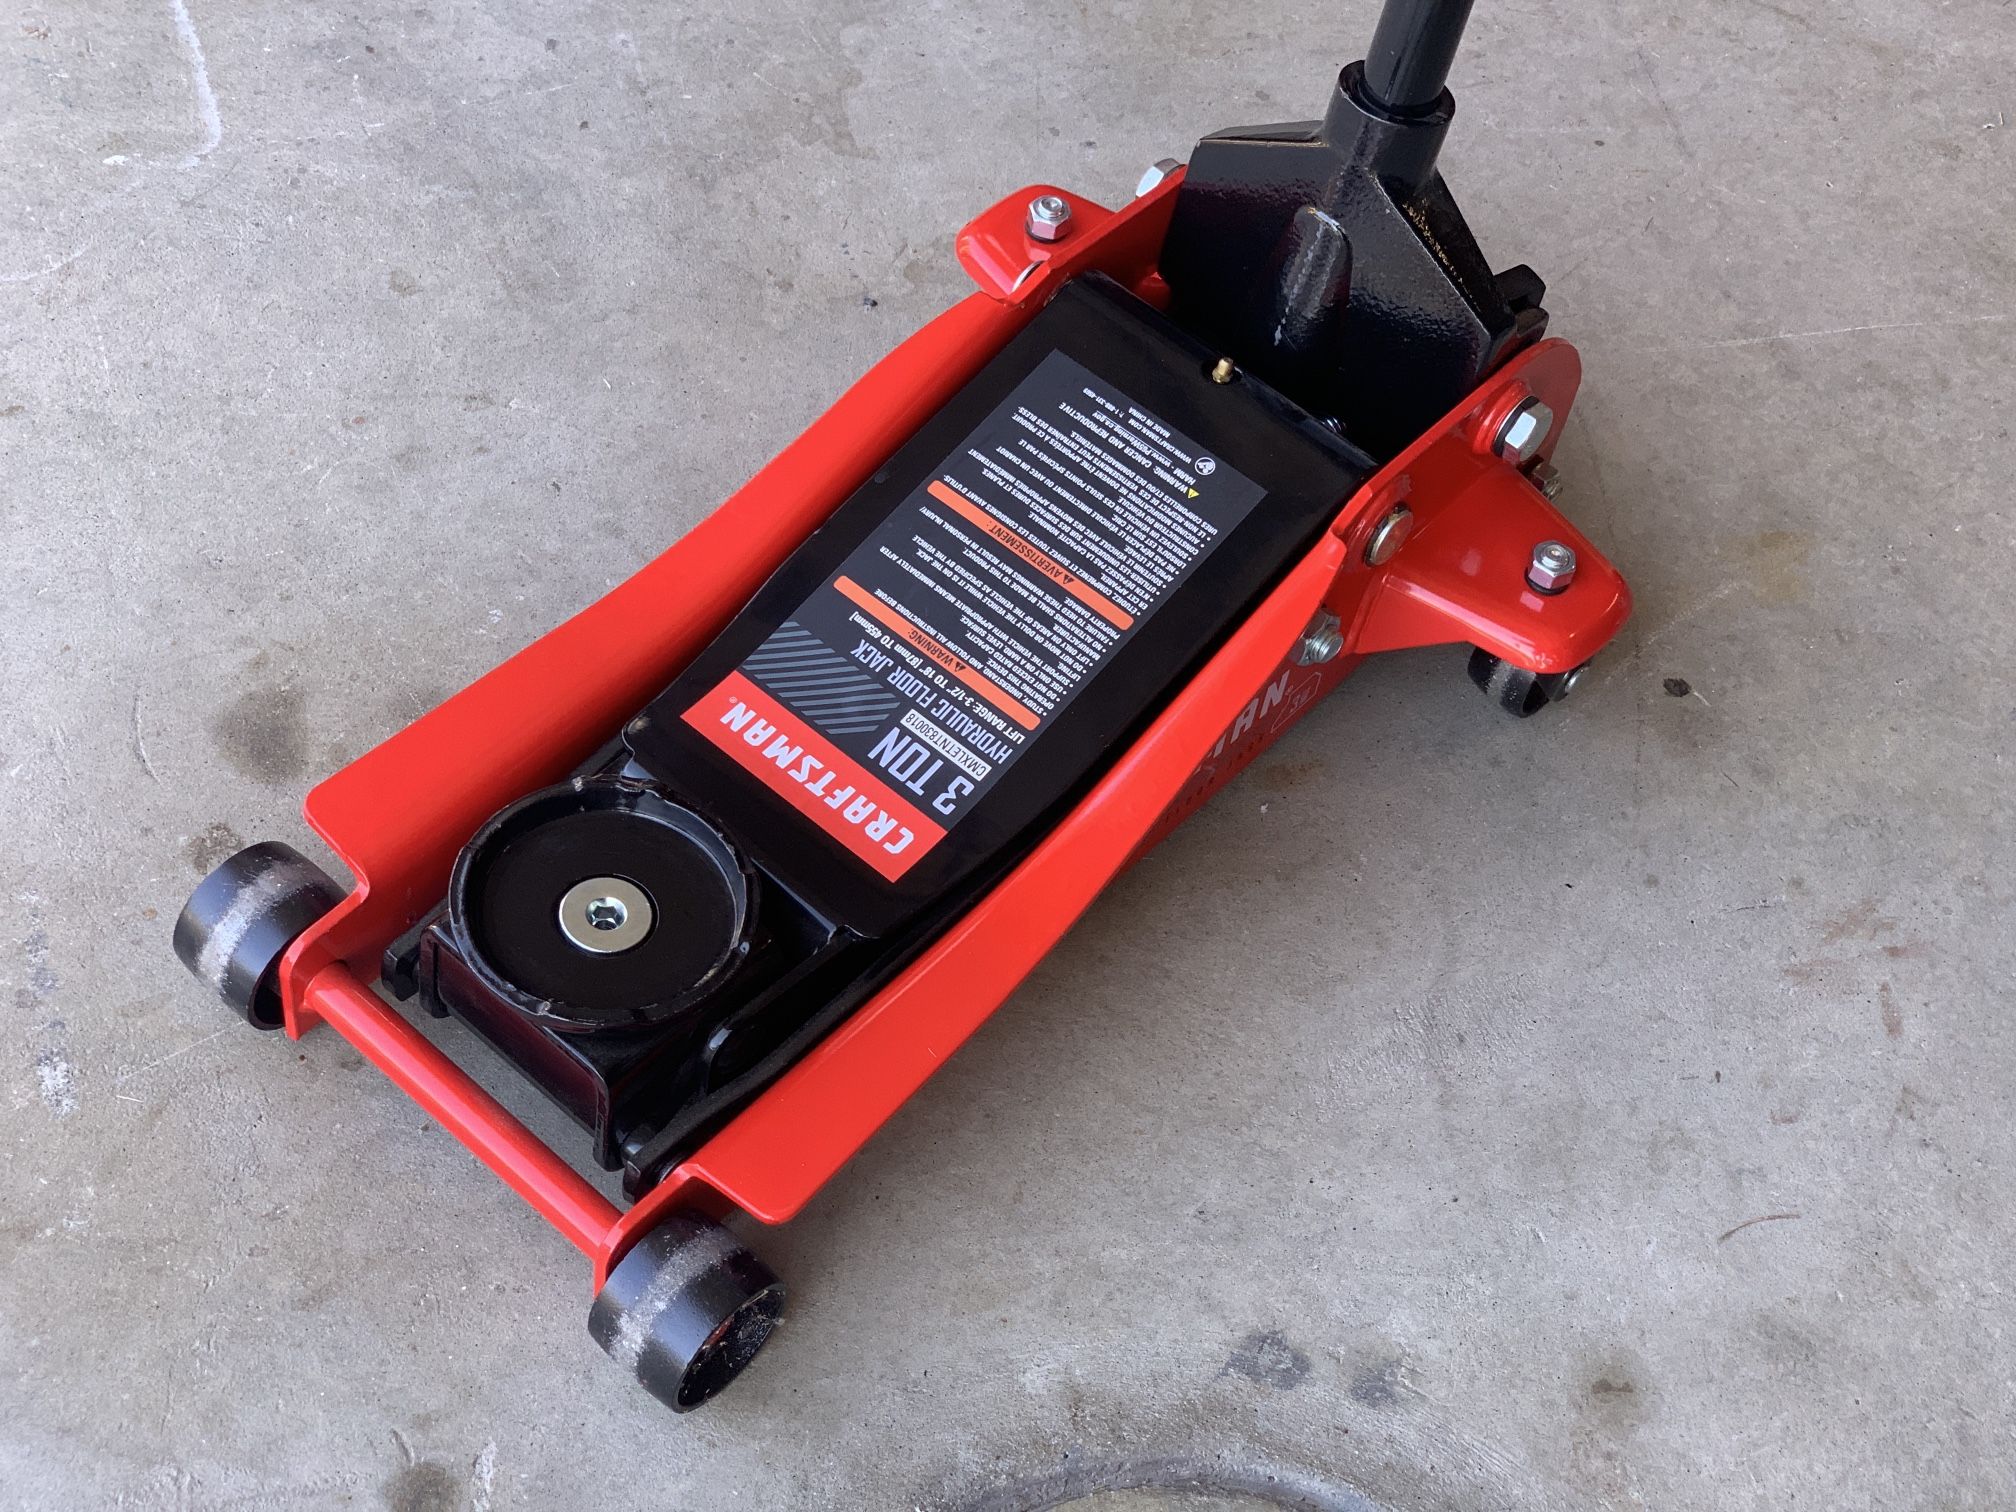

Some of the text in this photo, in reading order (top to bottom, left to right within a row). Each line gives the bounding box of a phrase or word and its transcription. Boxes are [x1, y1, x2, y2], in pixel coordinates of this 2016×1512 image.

[1128, 406, 1170, 438] MADE IN CHINA
[1058, 402, 1188, 493] WARNING: CANCER AND REPRODUCTIVE
[1128, 418, 1192, 464] WWW.CRAFTSMAN.COM
[1100, 452, 1136, 478] DOMMAGES
[943, 474, 968, 494] D'UTILIS-
[1133, 475, 1147, 486] DES
[1172, 467, 1196, 485] HARM
[1002, 483, 1013, 492] ET
[1145, 483, 1164, 498] ET/OU
[965, 491, 987, 506] AVANT
[1010, 488, 1031, 504] DURES
[984, 503, 1018, 529] CONSIGNES
[1029, 501, 1059, 524] SURFACES
[1162, 495, 1202, 524] CORPORELLES
[1057, 521, 1071, 532] DES
[1144, 515, 1155, 524] DU
[1016, 526, 1029, 537] LES
[1069, 529, 1083, 541] SUR
[1124, 524, 1134, 532] LE
[1132, 529, 1146, 540] SUR
[1200, 521, 1218, 535] URES
[1027, 533, 1050, 552] TOUTES
[1144, 538, 1158, 548] EST
[1153, 521, 1199, 555] CONSTRUCTEUR
[988, 525, 1063, 577] AVERTISSEMENT
[1048, 548, 1071, 566] SUIVEZ
[1080, 538, 1120, 567] UNIQUEMENT
[1085, 552, 1095, 561] LA
[1156, 545, 1186, 569] LORSQU'IL
[930, 559, 944, 571] THE
[1068, 563, 1078, 572] ET
[1093, 557, 1107, 569] PAS
[1145, 560, 1155, 569] LE
[919, 506, 1110, 644] FAILURE TO HEED THESE WARNINGS MAY RESULT IN PERSONAL INJURY/
[942, 567, 953, 577] ON
[951, 574, 960, 582] IS
[988, 566, 1003, 580] THIS
[1118, 564, 1156, 593] UTILISER-LES
[1002, 576, 1011, 585] TO
[1075, 568, 1112, 596] COMPRENEZ
[874, 588, 897, 607] BEFORE
[963, 583, 983, 600] WHILE
[1010, 581, 1029, 598] MADE
[1134, 586, 1150, 600] N'EN
[912, 534, 1090, 664] LIFT ONLY ON AREAS OF THE VEHICLE AS SPECIFIED BY THE VEHICLE
[981, 596, 1006, 616] VEHICLE
[1026, 594, 1038, 603] BE
[1126, 593, 1140, 604] CET
[1138, 600, 1148, 610] ER
[879, 545, 1070, 685] SUPPORT THE VEHICLE WITH APPROPRIATE MEANS IMMEDIATELY AFTER
[1036, 600, 1055, 616] SHALL
[895, 603, 937, 636] INSTRUCTIONS
[1004, 612, 1017, 624] THE
[1015, 621, 1036, 637] DOLLY
[1053, 613, 1094, 643] ALTERATIONS
[1088, 616, 1120, 640] PROPERTY
[880, 635, 894, 649] TO
[936, 632, 948, 643] ALL
[985, 633, 1004, 649] LEVEL
[1033, 633, 1044, 643] OR
[1091, 640, 1103, 650] NO
[908, 628, 954, 666] WARNING:
[945, 640, 970, 660] FOLLOW
[1042, 640, 1062, 656] MOVE
[968, 657, 984, 669] AND
[993, 651, 1014, 668] RATED
[1024, 662, 1036, 672] ON
[1059, 653, 1074, 665] NOT
[1072, 662, 1083, 672] DO
[933, 674, 948, 688] TO
[1006, 673, 1022, 686] THIS
[1011, 665, 1035, 684] EXCEED
[1033, 670, 1052, 684] ONLY
[1032, 681, 1048, 693] NOT
[1049, 680, 1063, 693] USE
[850, 639, 1013, 764] HYDRAULIC FLOOR JACK
[1020, 683, 1054, 710] OPERATING
[1046, 690, 1057, 700] DO
[972, 702, 1007, 731] RANGE:
[1002, 726, 1025, 744] LIFT
[905, 713, 986, 776] CMXLETNT830018
[719, 702, 914, 854] CRAFTSMAN
[867, 726, 974, 815] 3 TON
